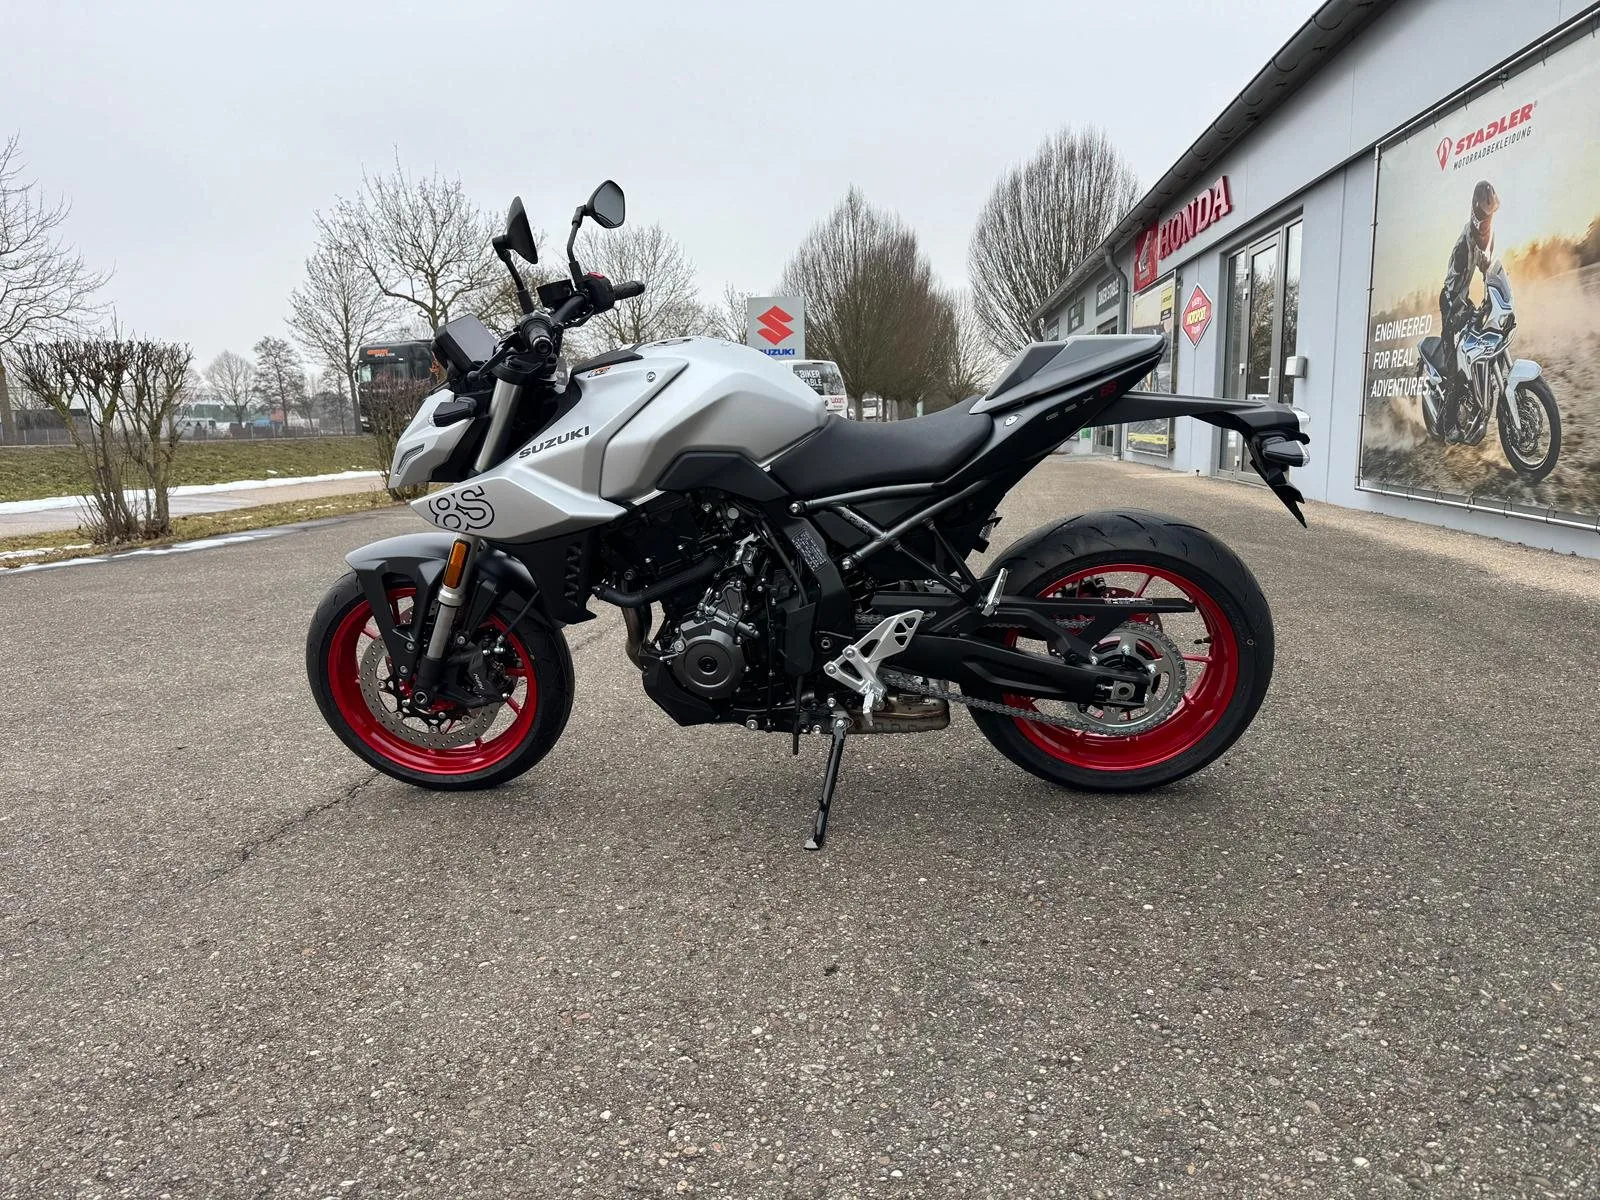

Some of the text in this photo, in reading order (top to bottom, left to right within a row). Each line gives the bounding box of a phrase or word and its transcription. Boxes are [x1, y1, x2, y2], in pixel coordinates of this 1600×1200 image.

[1455, 103, 1533, 155] STADLER
[1453, 126, 1532, 170] MOTORRADBEKLEIDUNG
[1158, 175, 1232, 260] HONDA
[1374, 314, 1433, 342] ENGINEERED
[800, 370, 820, 378] BIKER
[1372, 348, 1414, 370] FOR REAL
[1370, 376, 1431, 398] ADVENTURES.
[518, 425, 590, 459] SUZUKI
